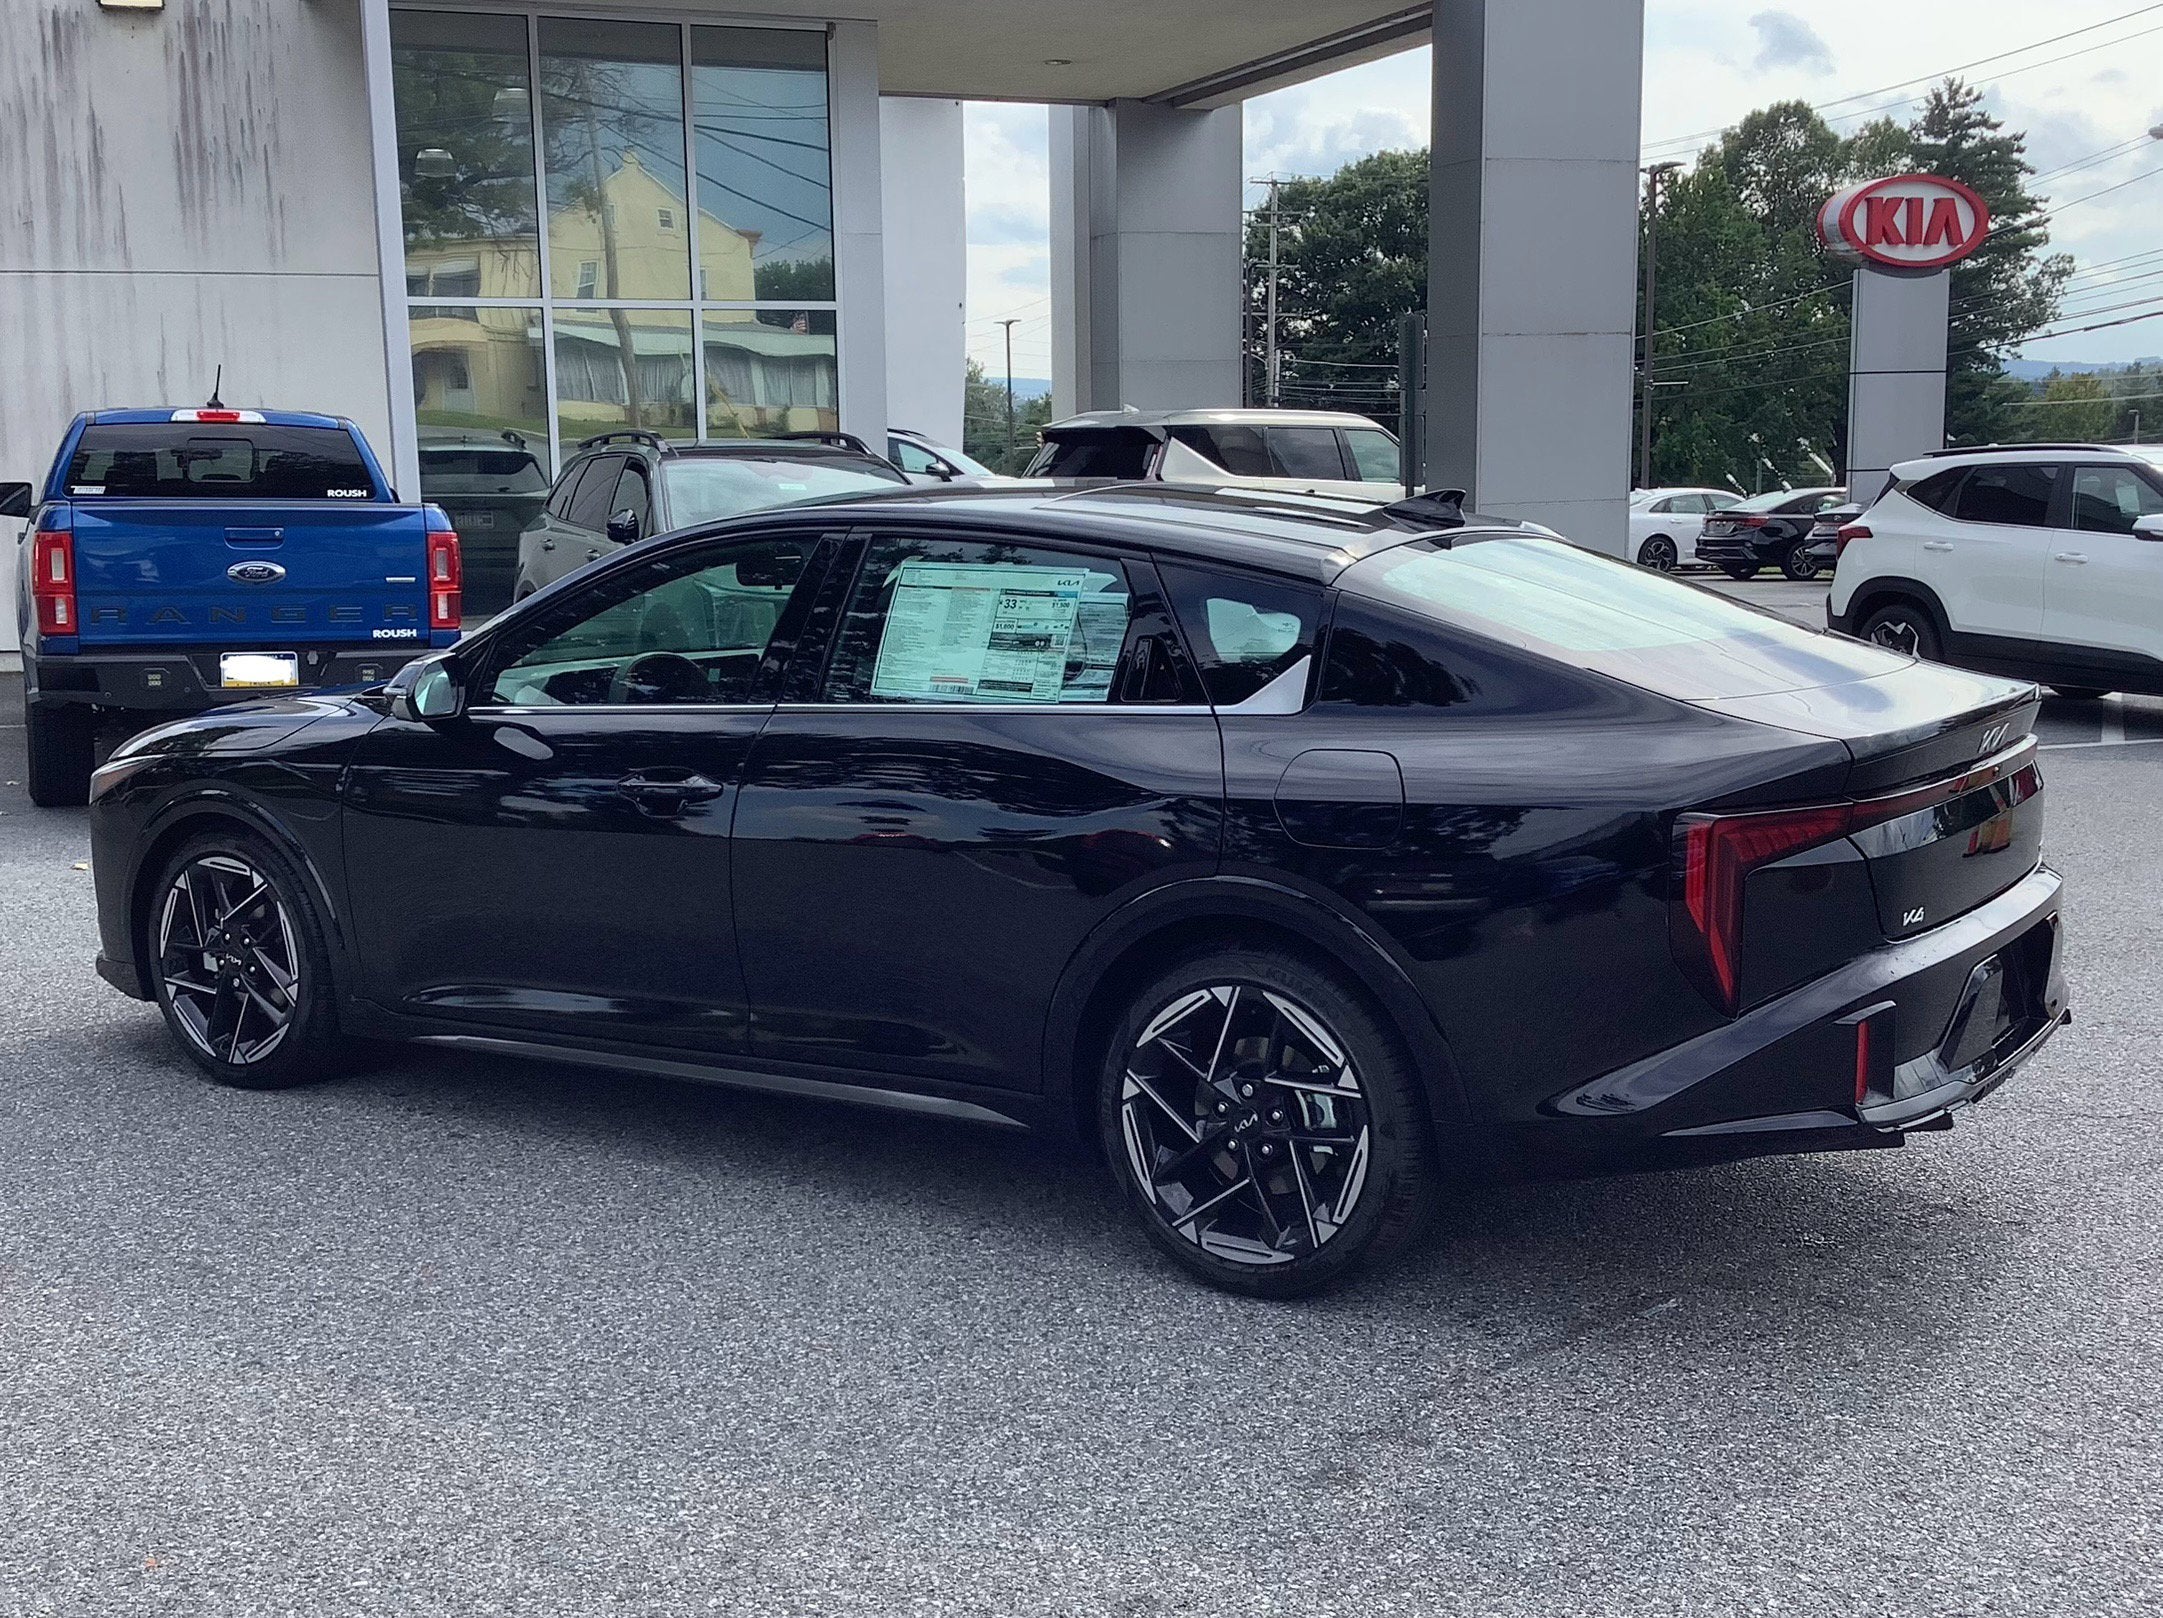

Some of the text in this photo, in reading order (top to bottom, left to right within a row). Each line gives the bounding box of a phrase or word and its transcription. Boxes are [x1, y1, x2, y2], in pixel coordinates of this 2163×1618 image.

[1864, 197, 1964, 246] KIA
[327, 489, 368, 498] ROUSH
[1057, 579, 1080, 587] KIA
[1003, 598, 1018, 610] 33
[90, 605, 418, 625] RANGER
[372, 628, 417, 639] ROUSH
